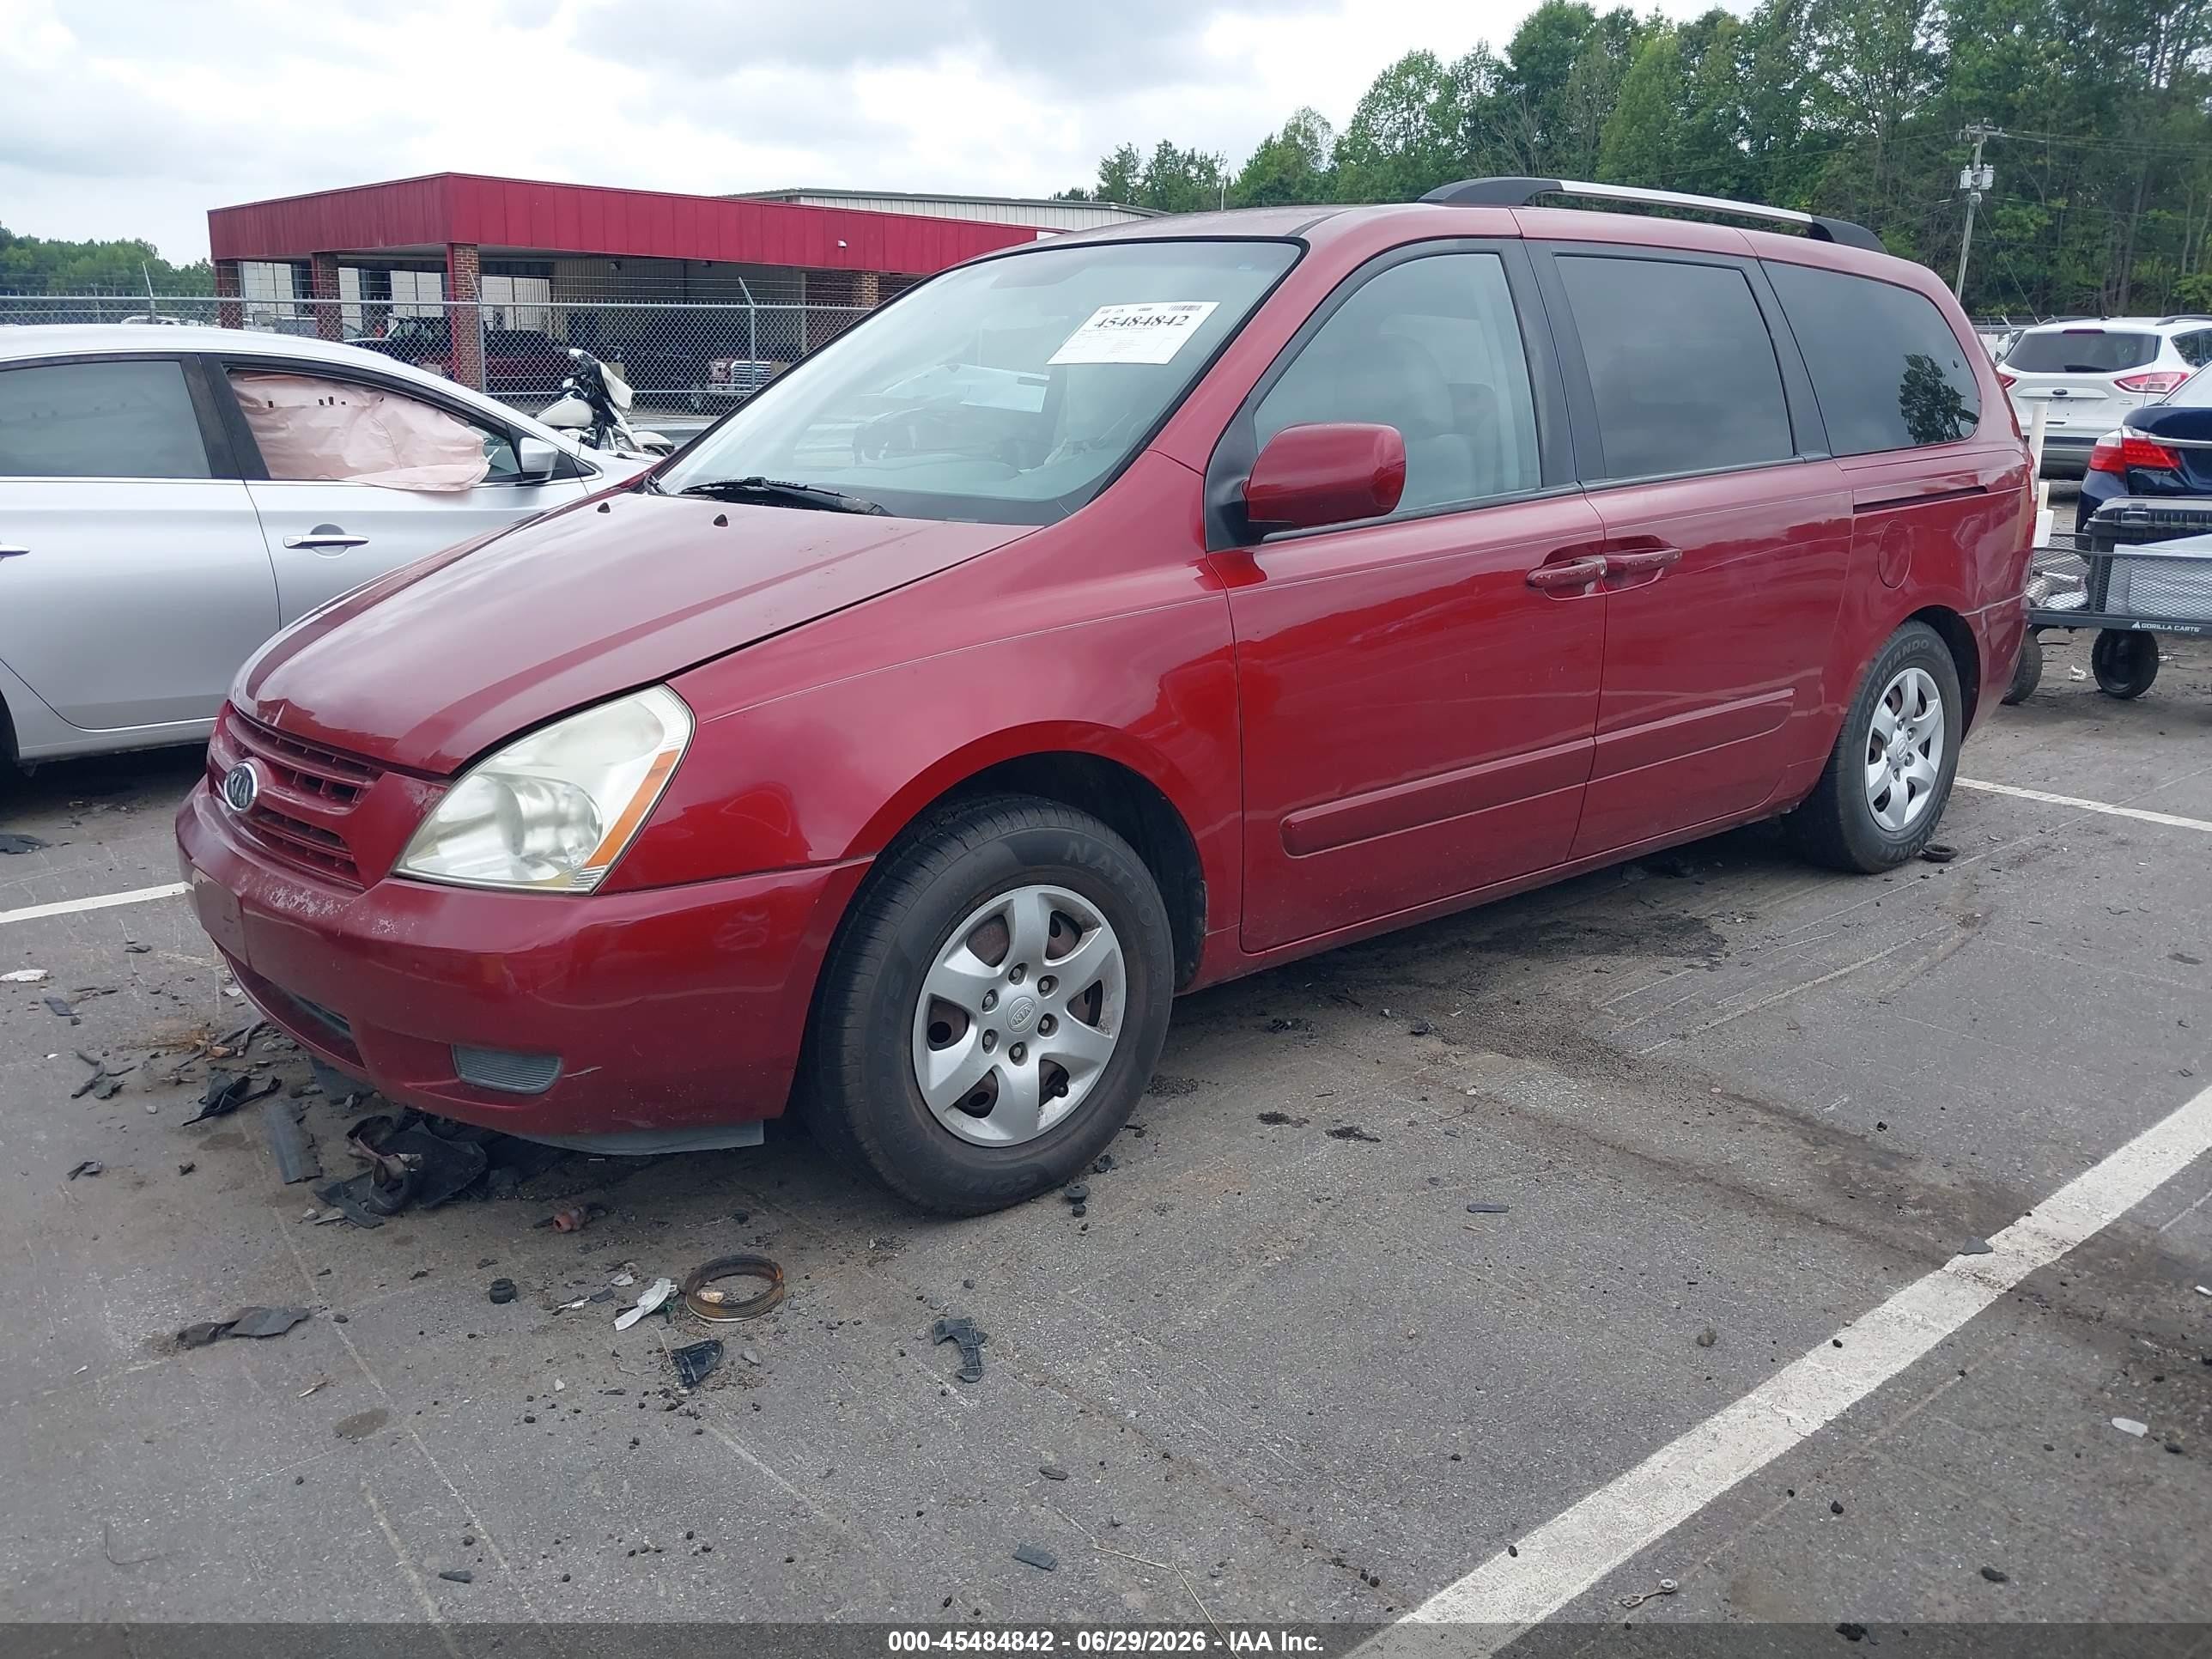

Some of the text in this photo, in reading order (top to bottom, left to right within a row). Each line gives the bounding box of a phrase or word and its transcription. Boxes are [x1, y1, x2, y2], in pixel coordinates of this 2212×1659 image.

[1094, 314, 1190, 328] 45484842
[2141, 623, 2172, 631] GORILLA
[1012, 1006, 1031, 1026] KIA
